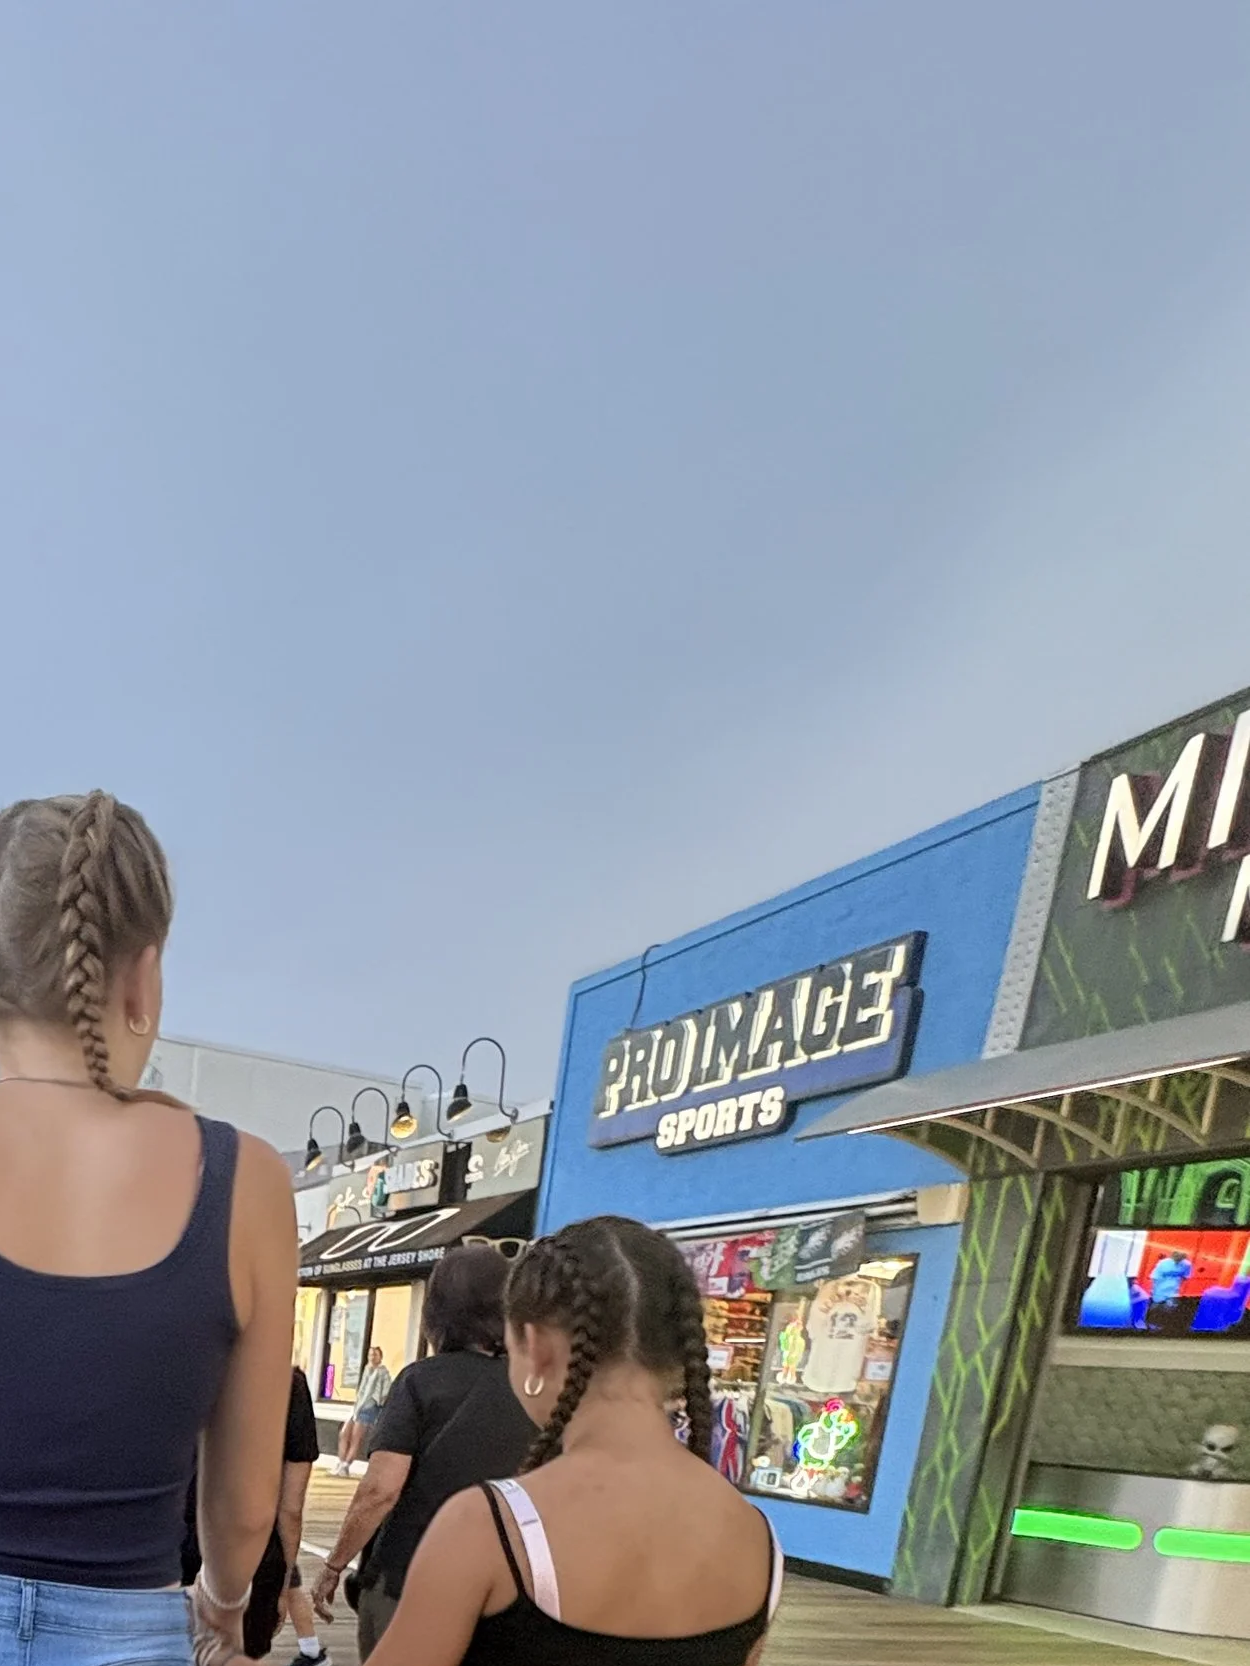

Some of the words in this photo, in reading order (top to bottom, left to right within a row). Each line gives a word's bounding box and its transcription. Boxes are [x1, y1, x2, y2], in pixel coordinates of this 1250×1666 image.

[655, 1085, 786, 1149] SPORTS
[363, 1256, 373, 1269] AT
[373, 1254, 388, 1267] THE
[388, 1251, 417, 1266] JERSEY
[417, 1246, 446, 1263] SHORE
